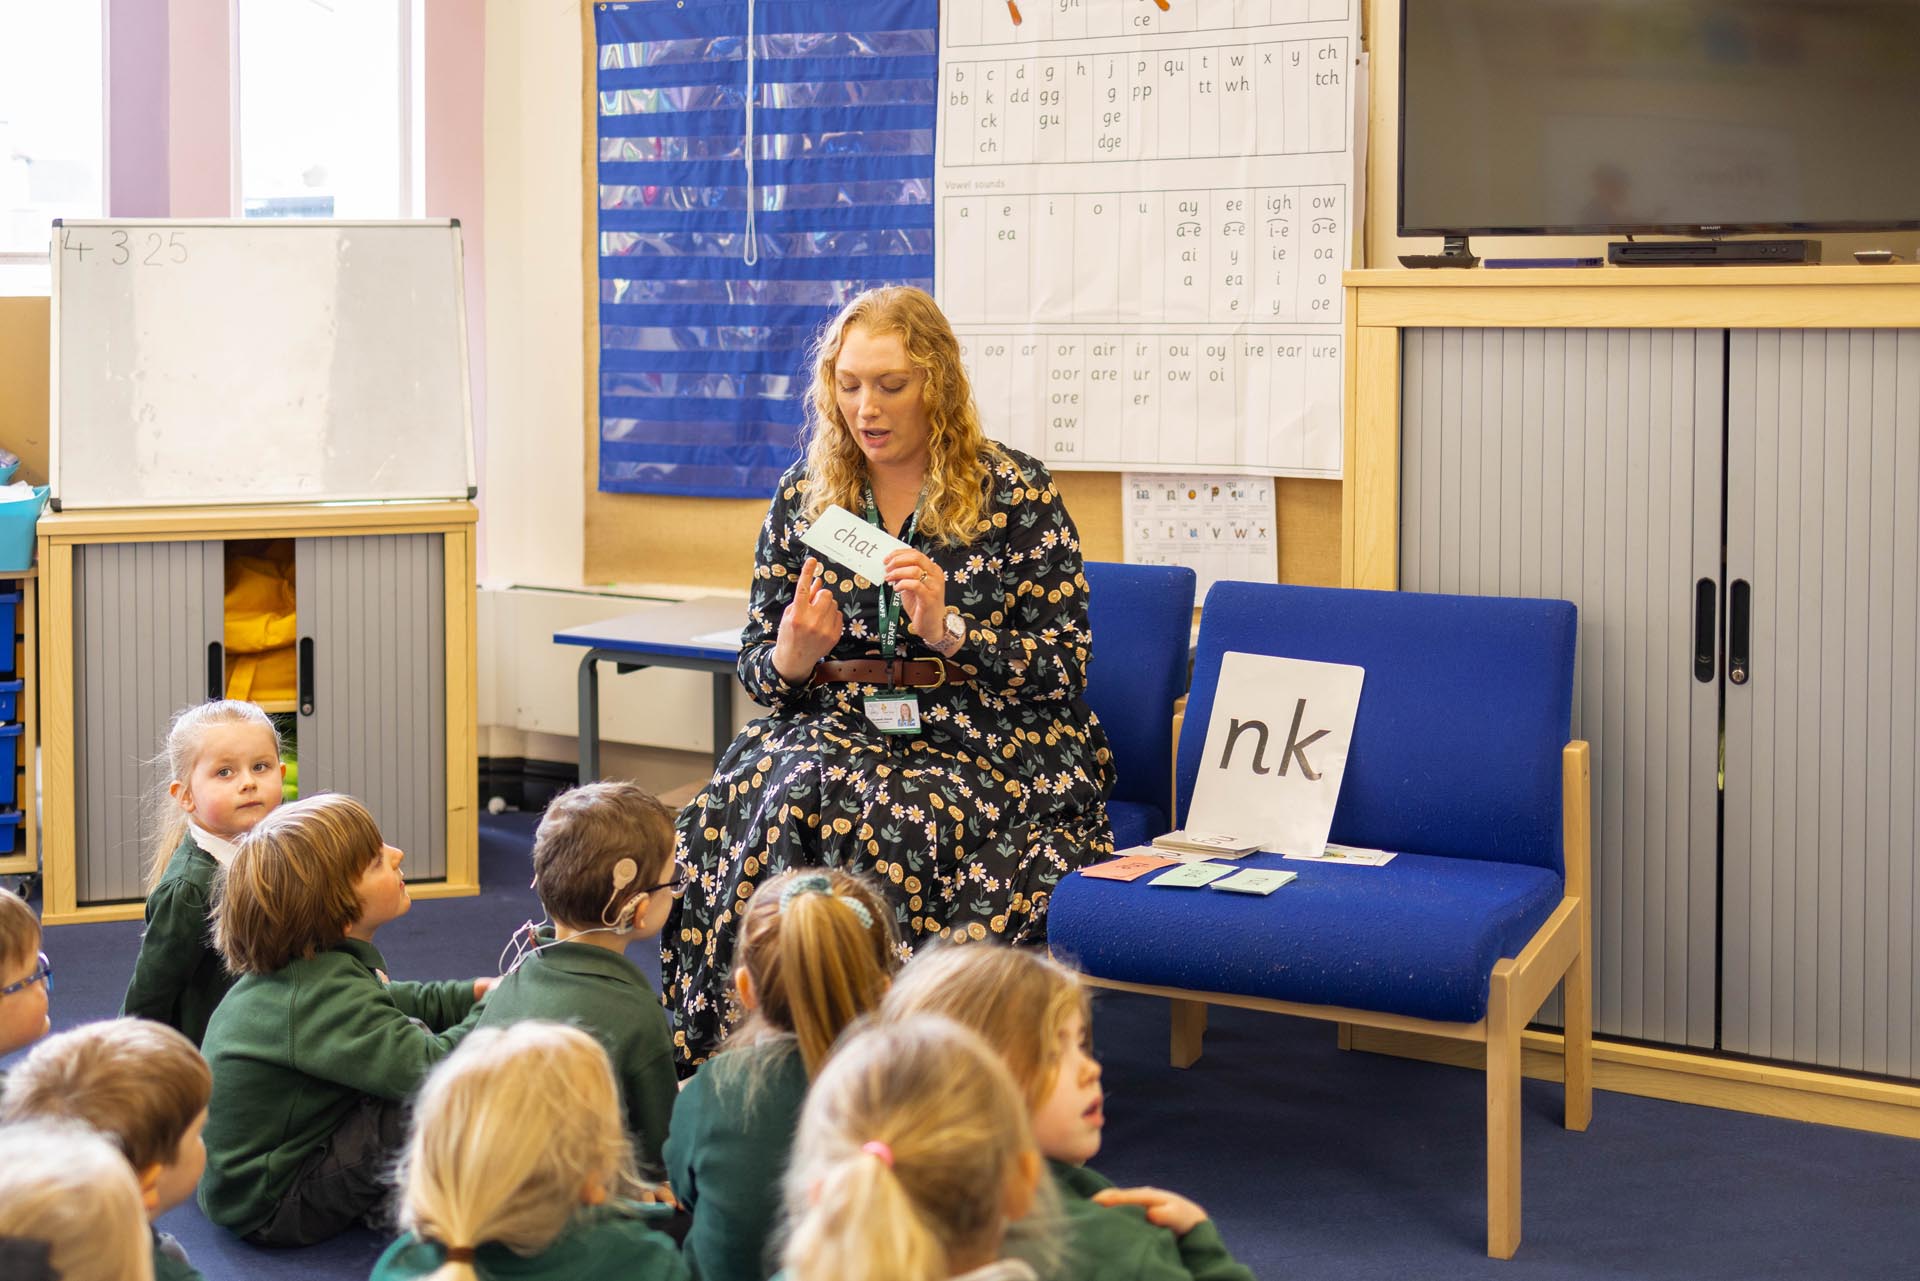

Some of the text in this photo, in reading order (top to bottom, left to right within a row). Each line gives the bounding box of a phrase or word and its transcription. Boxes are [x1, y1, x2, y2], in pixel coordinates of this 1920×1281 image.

[1133, 16, 1151, 27] ce
[955, 68, 965, 83] b
[986, 70, 995, 81] c
[1015, 65, 1025, 80] d
[1045, 67, 1055, 82] g
[1076, 61, 1086, 76] h
[1137, 62, 1147, 76] p
[1163, 61, 1185, 77] qu
[1230, 56, 1245, 67] w
[1263, 54, 1272, 64] x
[1291, 51, 1300, 67] y
[1318, 44, 1337, 60] ch
[950, 69, 1340, 106] bb k dd gg g pp tt wh tch
[980, 112, 1121, 130] ck gu ge
[979, 134, 1122, 153] ch dge
[960, 208, 969, 218] a
[1002, 206, 1012, 217] e
[1093, 204, 1103, 215] o
[1138, 203, 1147, 214] u
[1178, 202, 1198, 217] ay
[1225, 201, 1242, 212] ee
[1266, 195, 1292, 215] igh
[1312, 197, 1336, 209] ow
[997, 230, 1017, 241] ea
[111, 230, 130, 265] 3
[1181, 246, 1334, 266] ai y ie oa
[1183, 276, 1193, 287] a
[1225, 275, 1243, 287] ea
[1317, 274, 1327, 286] o
[1230, 299, 1331, 316] e y oe
[1057, 346, 1076, 357] or
[1092, 343, 1117, 357] air
[1135, 343, 1148, 357] ir
[1168, 346, 1189, 358] ou
[1206, 347, 1226, 362] oy
[1244, 343, 1264, 358] ire
[1276, 346, 1303, 358] ear
[1312, 347, 1337, 359] ure
[1051, 367, 1225, 382] oor are ur ow oi
[1051, 394, 1150, 406] ore er
[1052, 418, 1078, 429] aw
[1054, 442, 1075, 453] au
[865, 488, 875, 510] STAFF
[833, 527, 879, 558] chat
[887, 620, 897, 646] STAFF
[1219, 698, 1332, 781] nk
